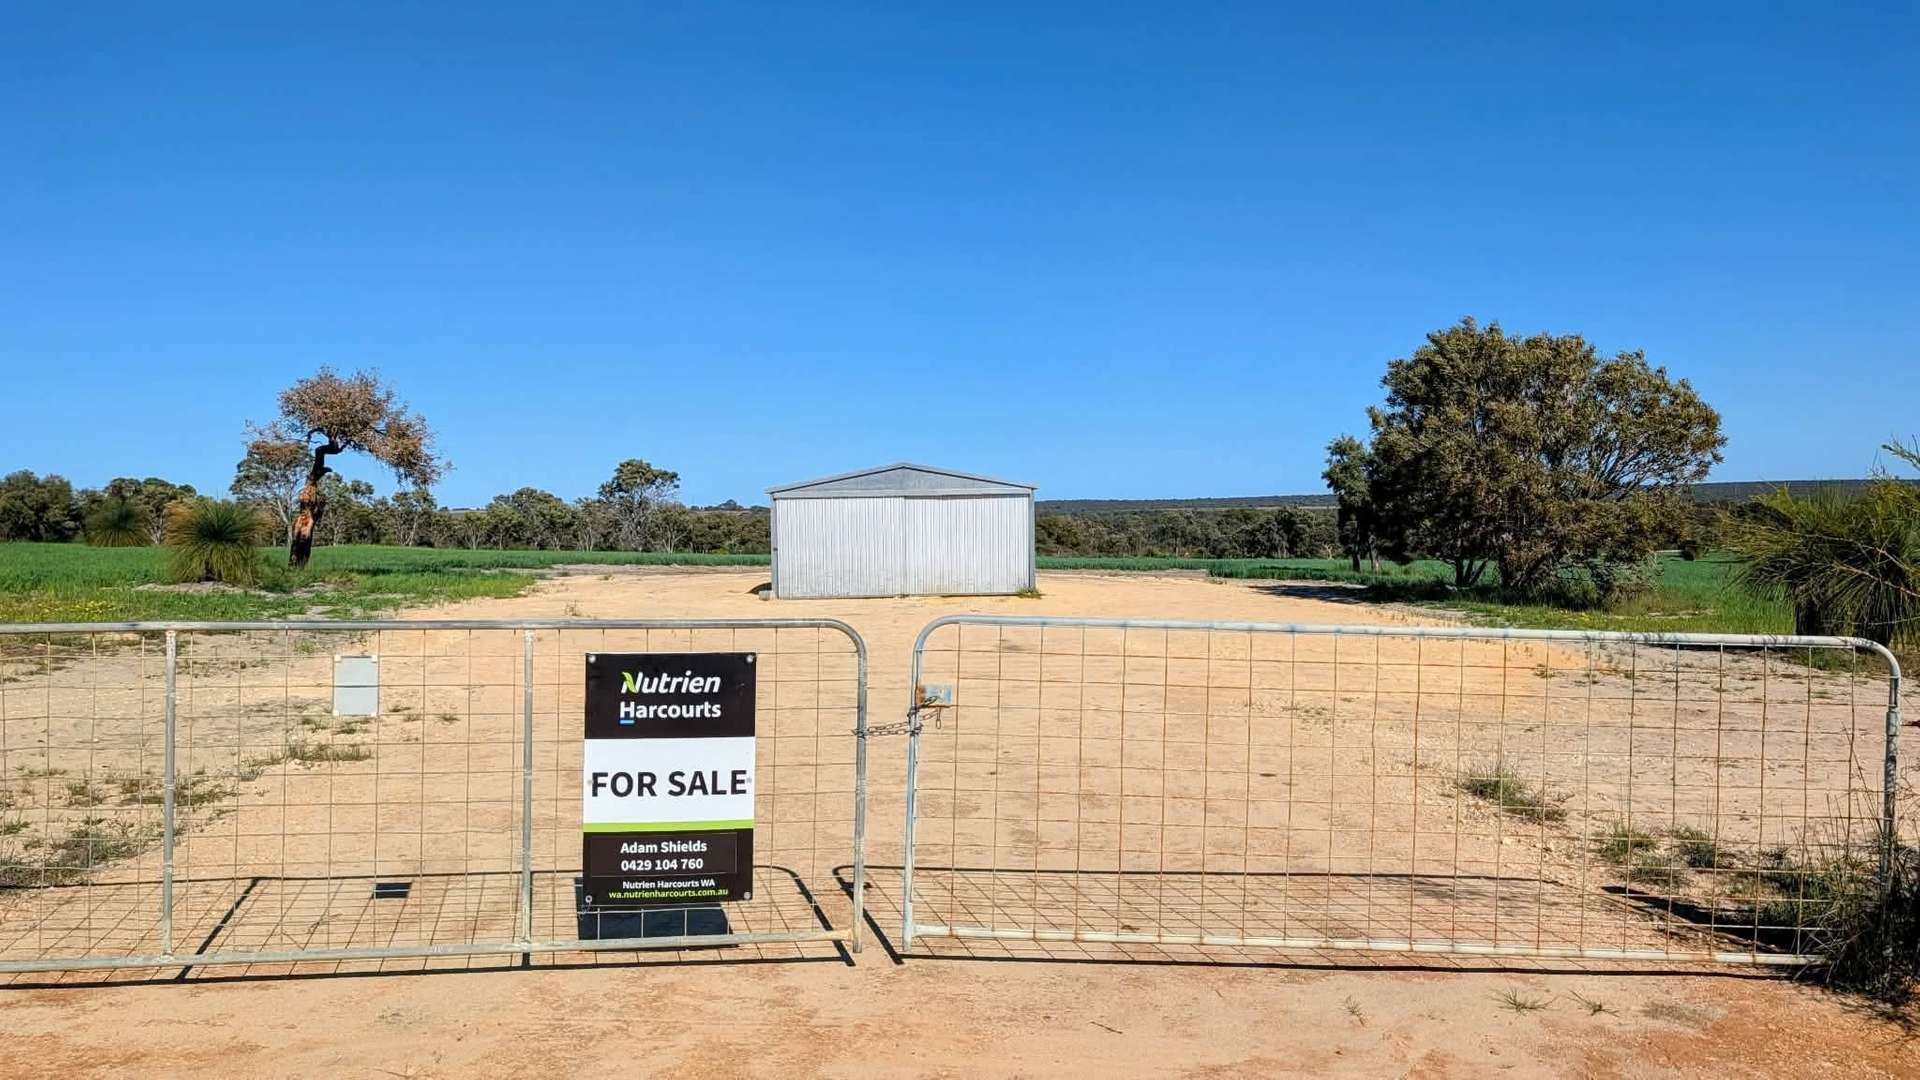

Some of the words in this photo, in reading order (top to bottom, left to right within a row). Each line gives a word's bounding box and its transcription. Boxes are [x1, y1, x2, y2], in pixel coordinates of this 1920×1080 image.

[620, 670, 721, 694] Nutrien
[619, 701, 722, 718] Harcourts
[591, 771, 657, 798] FOR
[667, 770, 747, 797] SALE
[620, 842, 658, 854] Adam
[660, 840, 708, 853] Shields
[620, 859, 652, 871] 0429
[654, 859, 678, 870] 104
[680, 858, 704, 870] 760
[622, 880, 656, 889] Nutrien
[657, 879, 700, 888] Harcourts
[700, 879, 716, 887] WA
[608, 888, 729, 899] wa.nutrienharcourts.com.au
